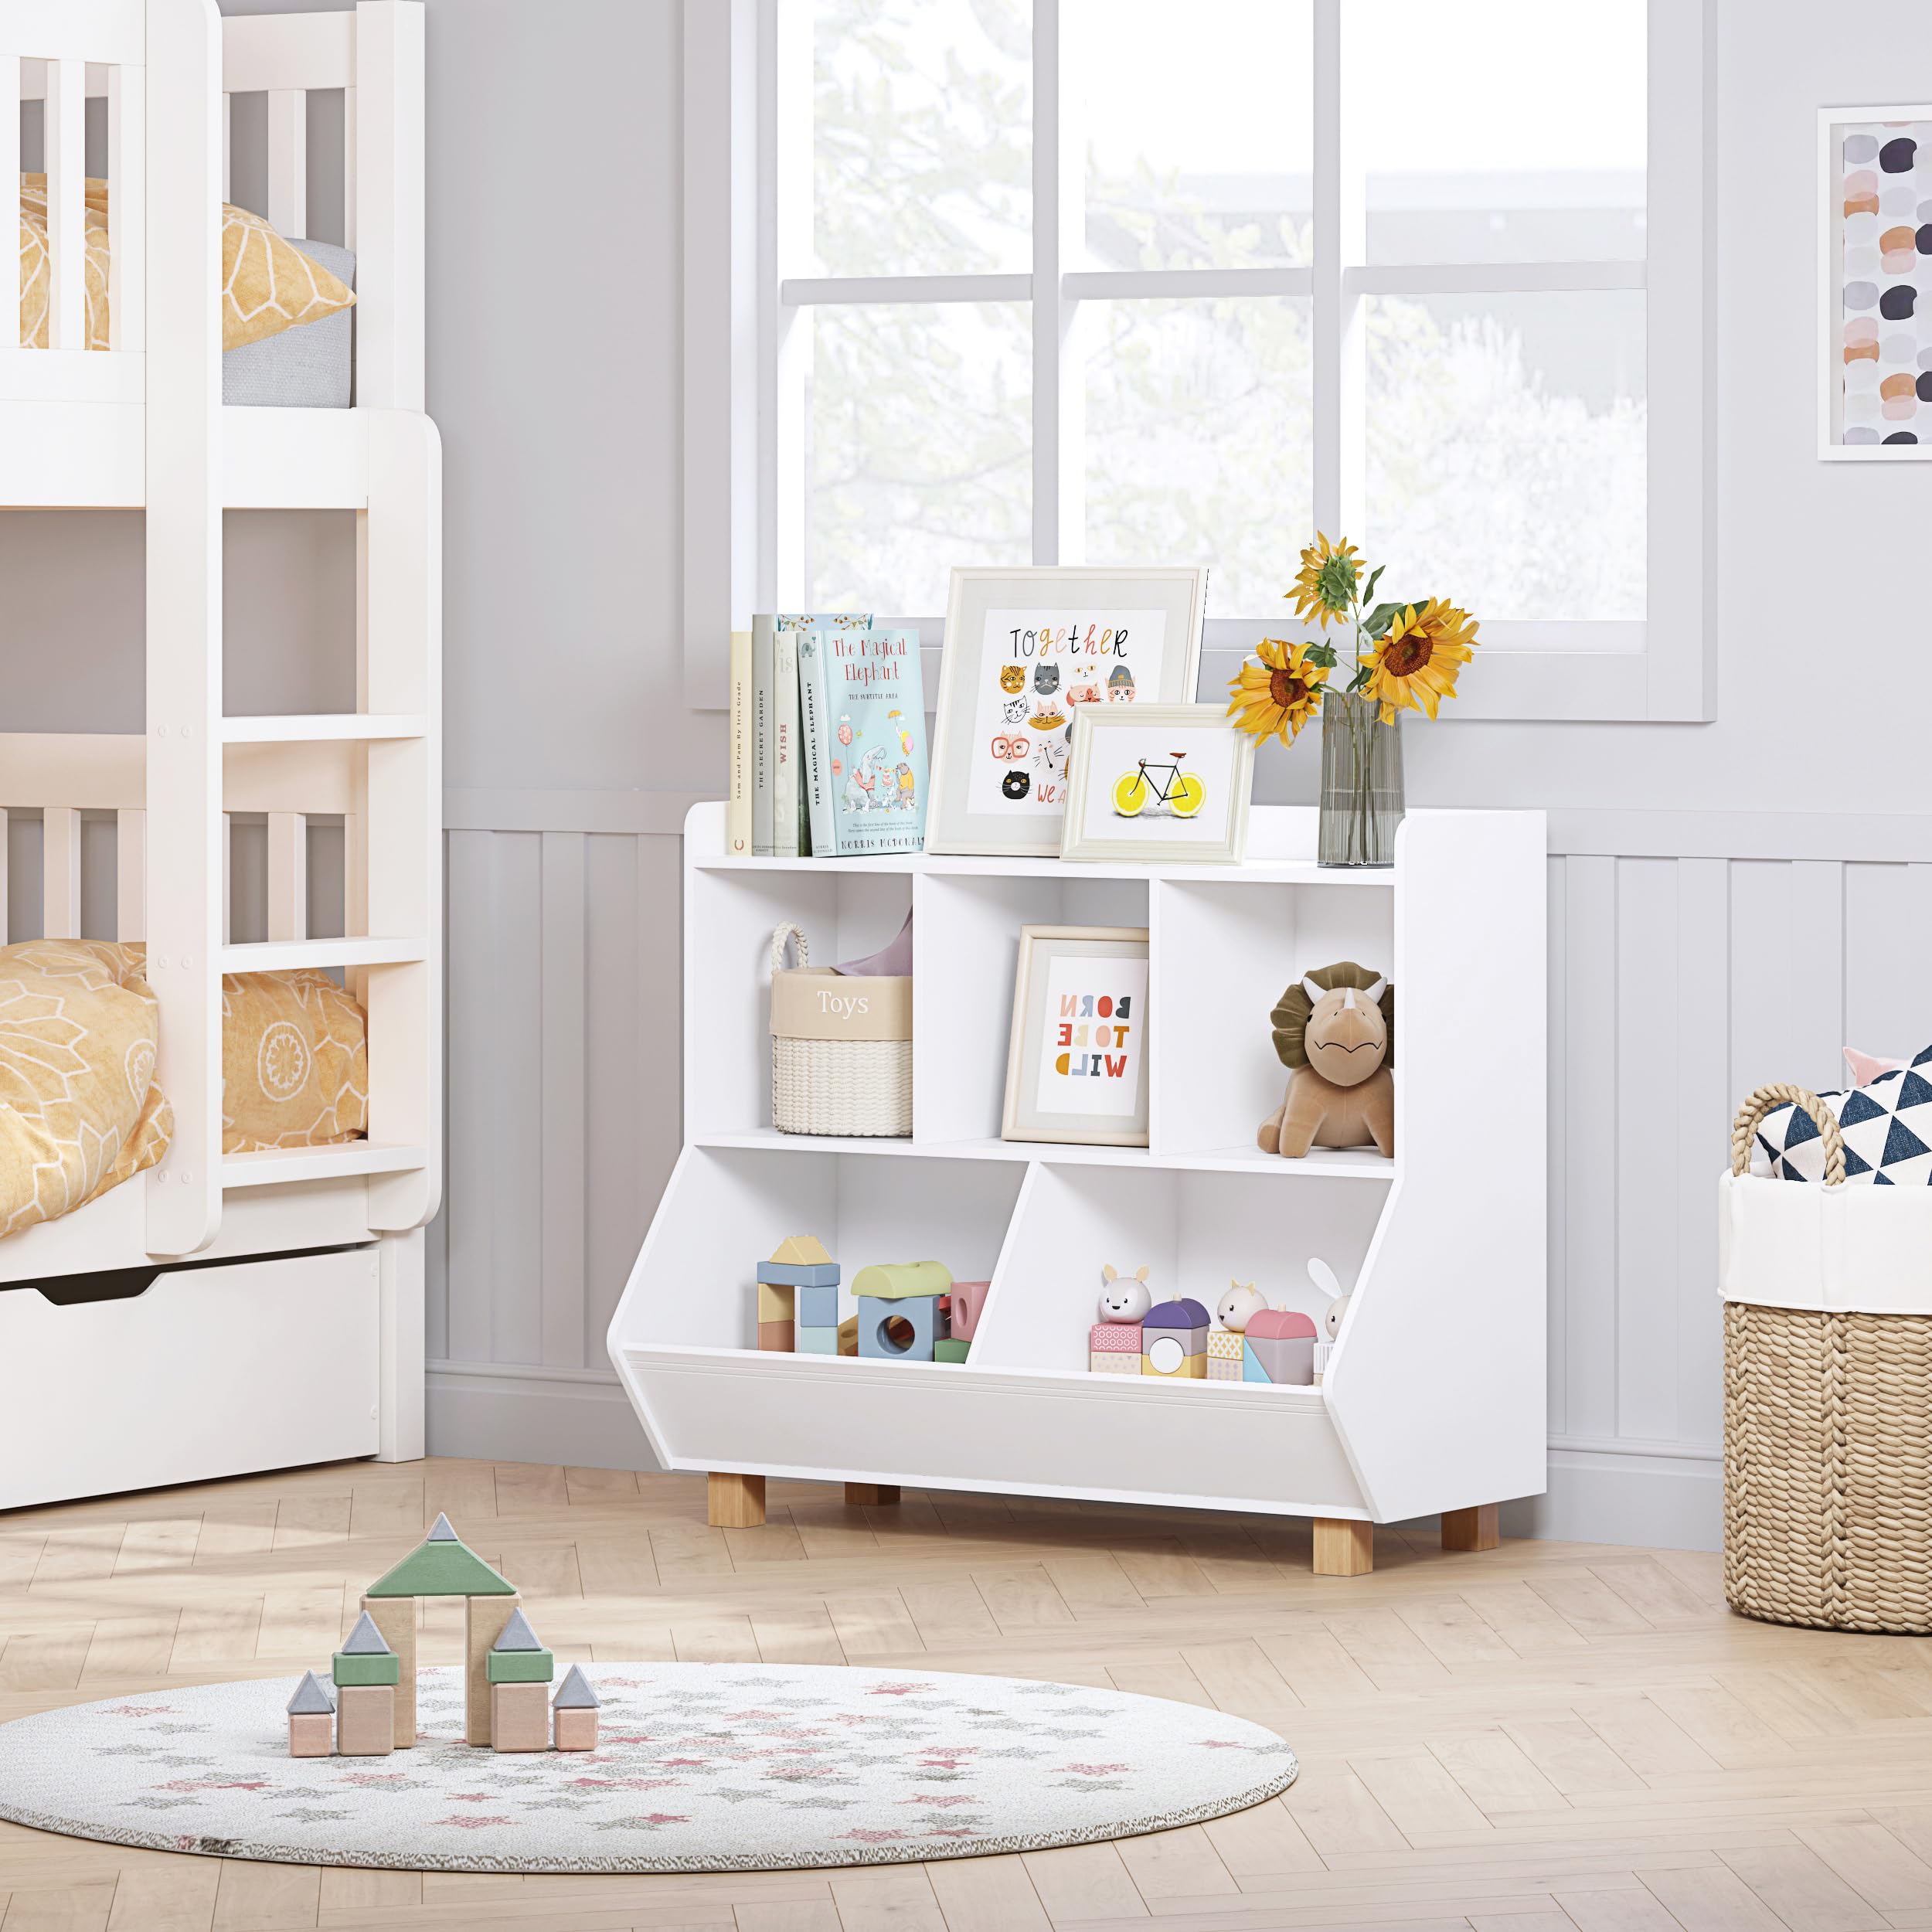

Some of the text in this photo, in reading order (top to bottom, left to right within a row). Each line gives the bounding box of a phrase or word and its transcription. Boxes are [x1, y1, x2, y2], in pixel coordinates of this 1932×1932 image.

[832, 638, 907, 662] The Magical
[845, 661, 900, 686] Elephant
[807, 682, 815, 733] ELEPHANT
[842, 839, 875, 849] NORRIS
[816, 990, 869, 1020] Toys
